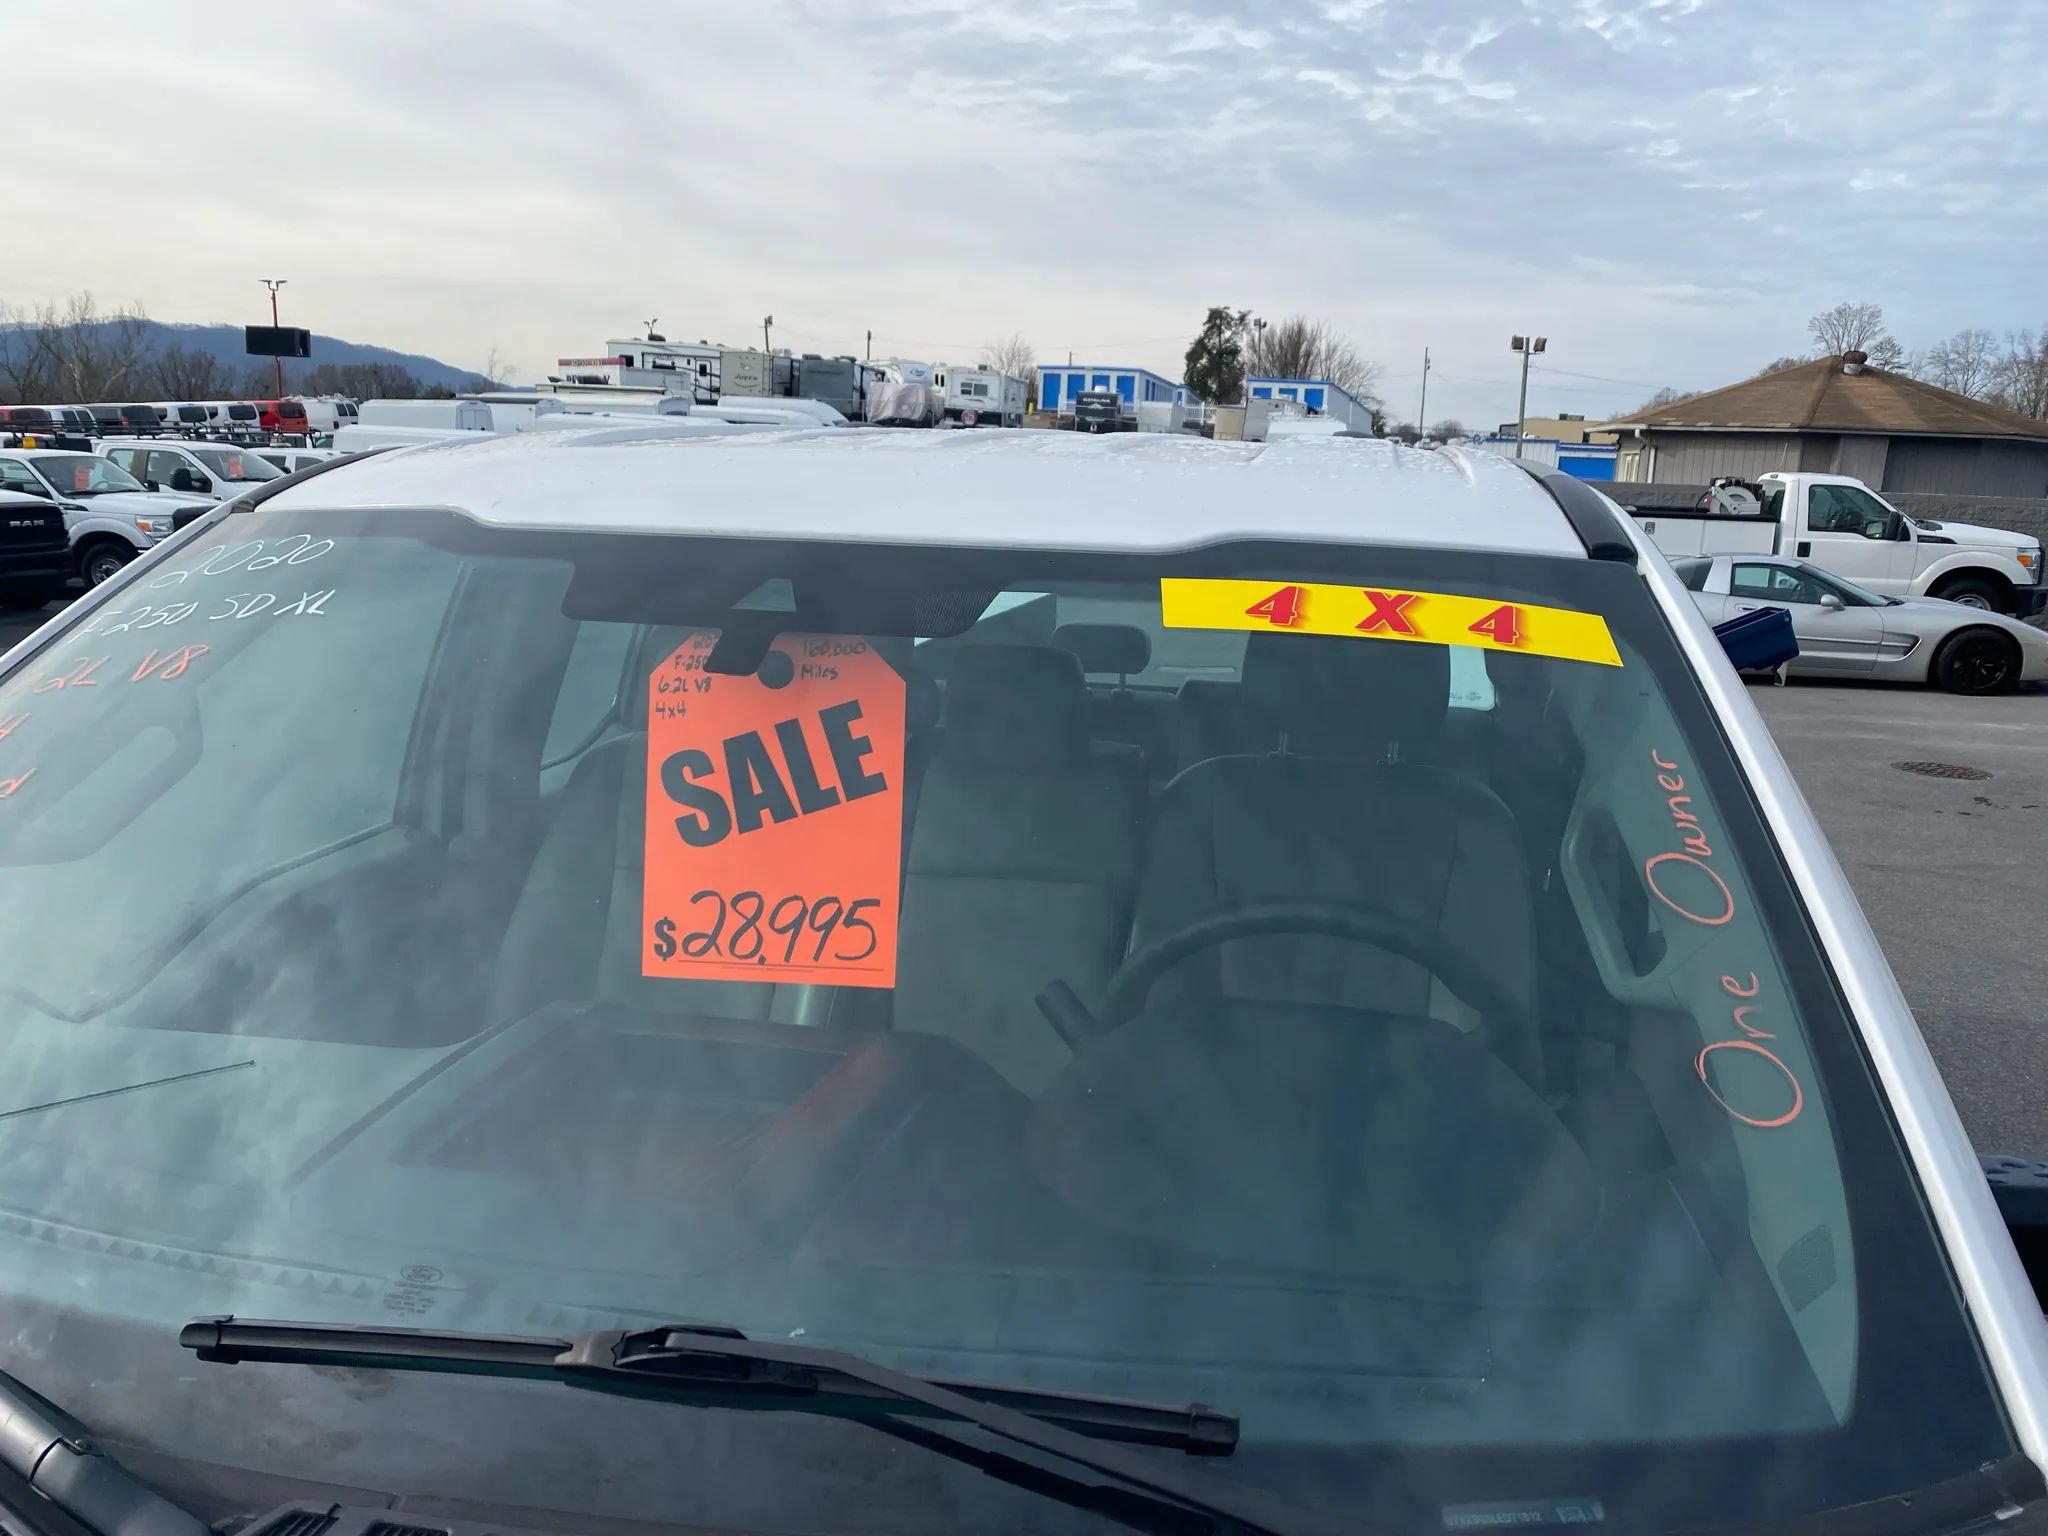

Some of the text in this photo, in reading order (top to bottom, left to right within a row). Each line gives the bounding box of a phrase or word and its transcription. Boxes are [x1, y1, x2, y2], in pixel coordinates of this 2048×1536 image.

[9, 519, 45, 528] RAM
[149, 534, 335, 590] 2020
[209, 593, 276, 620] SD
[273, 589, 336, 617] XL
[1245, 585, 1523, 646] 4 X 4
[131, 644, 209, 683] V8
[801, 664, 839, 681] Miles
[658, 675, 713, 694] 6.2L V8
[655, 700, 687, 718] 4x4
[660, 699, 888, 848] SALE
[1645, 748, 1804, 1128] One Owner
